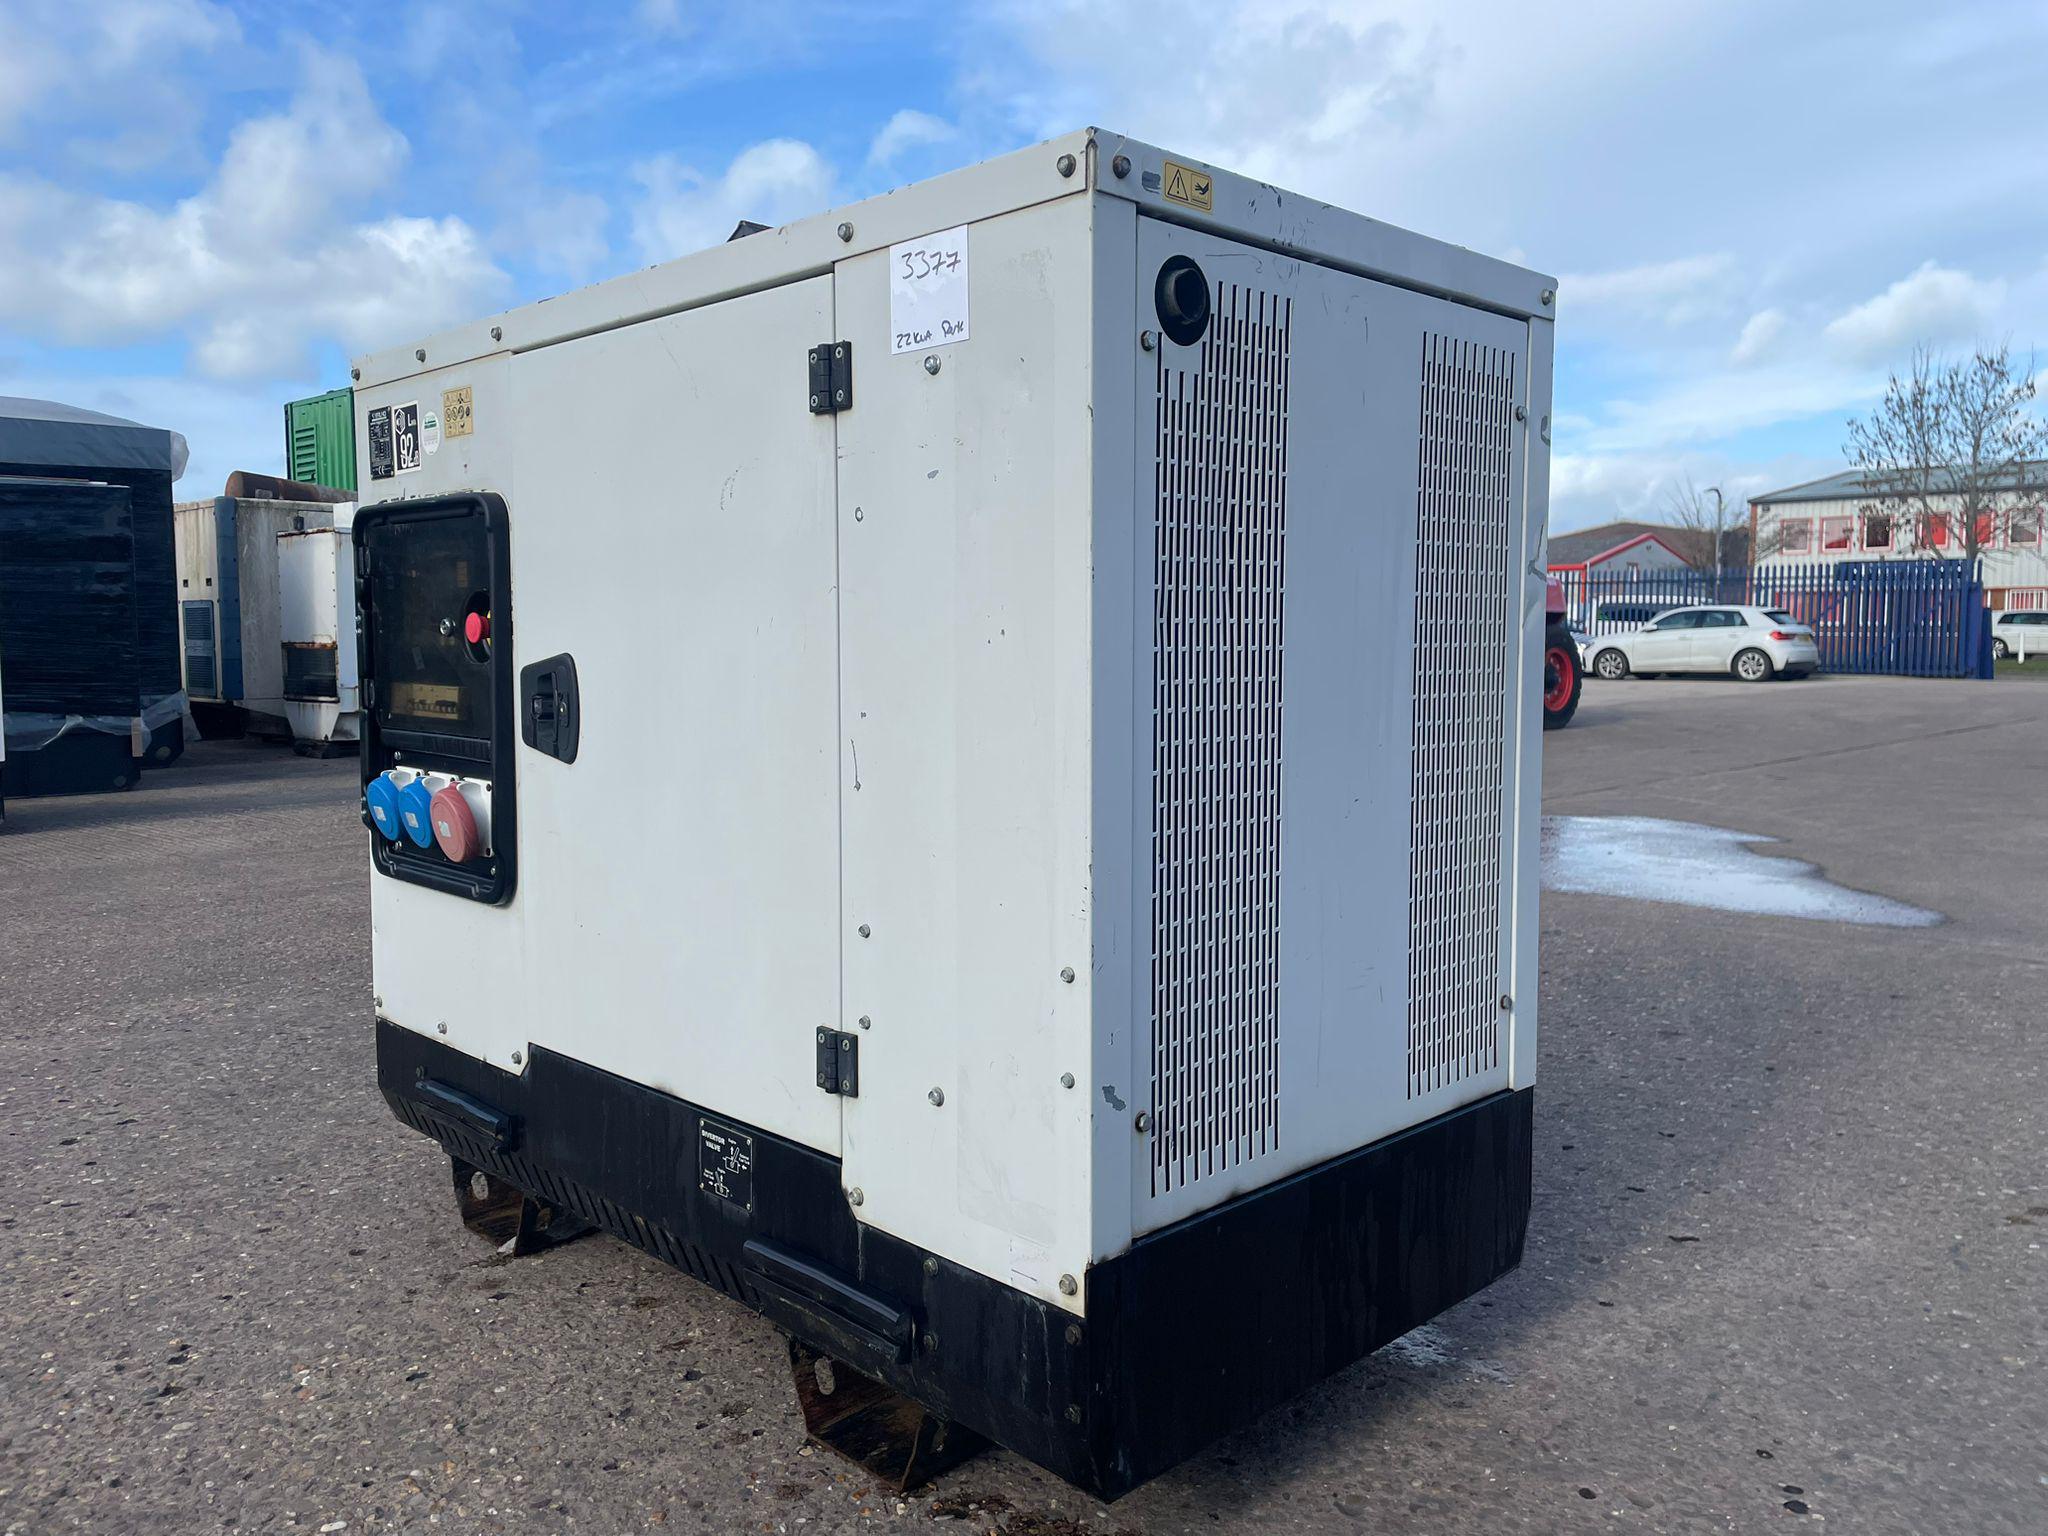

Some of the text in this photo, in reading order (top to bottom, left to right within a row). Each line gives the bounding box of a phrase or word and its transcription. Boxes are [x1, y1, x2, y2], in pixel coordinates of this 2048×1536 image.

[902, 250, 961, 280] 3377
[400, 433, 415, 469] 92
[706, 1140, 721, 1152] VALVE
